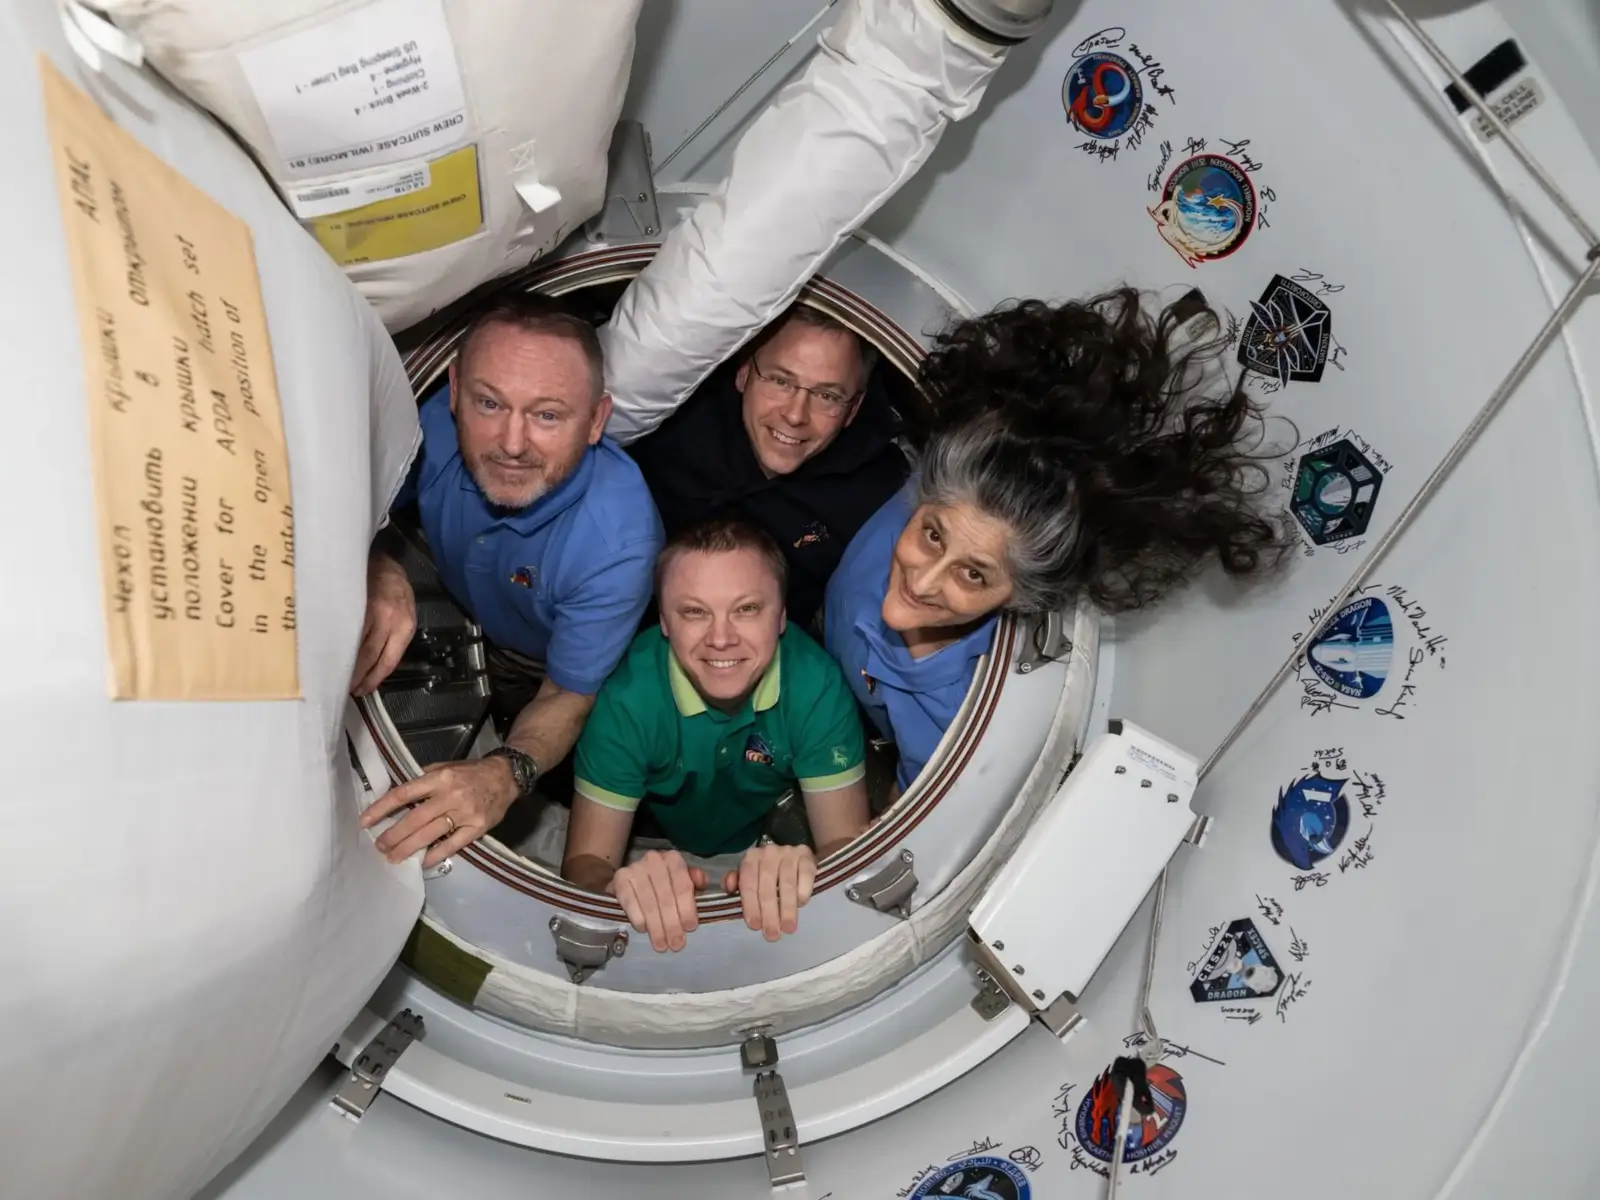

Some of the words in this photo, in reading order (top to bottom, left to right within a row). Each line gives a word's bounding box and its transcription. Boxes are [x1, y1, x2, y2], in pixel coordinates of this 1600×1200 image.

[337, 62, 359, 77] Bag
[359, 46, 402, 69] Sleeping
[383, 55, 421, 76] Hygiene
[310, 71, 338, 87] Liner
[386, 68, 425, 88] Clothing
[396, 81, 429, 99] 2-Week
[369, 93, 394, 110] Brick
[432, 114, 464, 132] CREW
[377, 126, 431, 152] SUITCASE
[307, 146, 374, 166] (WILMORE)
[1209, 158, 1244, 182] MOGENSEN
[64, 147, 101, 224] АПАС
[397, 202, 441, 219] SUITCASE
[442, 193, 466, 207] CREW
[1242, 184, 1253, 222] MOGHBELI
[174, 234, 201, 275] set
[1281, 279, 1323, 309] CRISTOFORETTI
[186, 290, 215, 353] hatch
[219, 296, 242, 324] of
[1318, 333, 1329, 364] WATKINS
[172, 335, 203, 433] крышки
[229, 331, 261, 417] position
[210, 389, 236, 456] APDA
[253, 449, 272, 504] open
[214, 498, 236, 535] for
[140, 447, 176, 621] установить
[181, 476, 202, 621] положении
[111, 524, 135, 614] Чехол
[248, 544, 268, 581] the
[214, 558, 236, 629] Cover
[280, 596, 296, 632] the
[1340, 599, 1372, 618] DRAGON
[249, 613, 269, 634] in
[1314, 664, 1335, 686] CRS-22
[1340, 684, 1362, 697] NASA
[1248, 928, 1269, 959] SPACEX
[1207, 989, 1247, 1000] DRAGON
[1000, 1162, 1028, 1188] ФЕДЯЕВ
